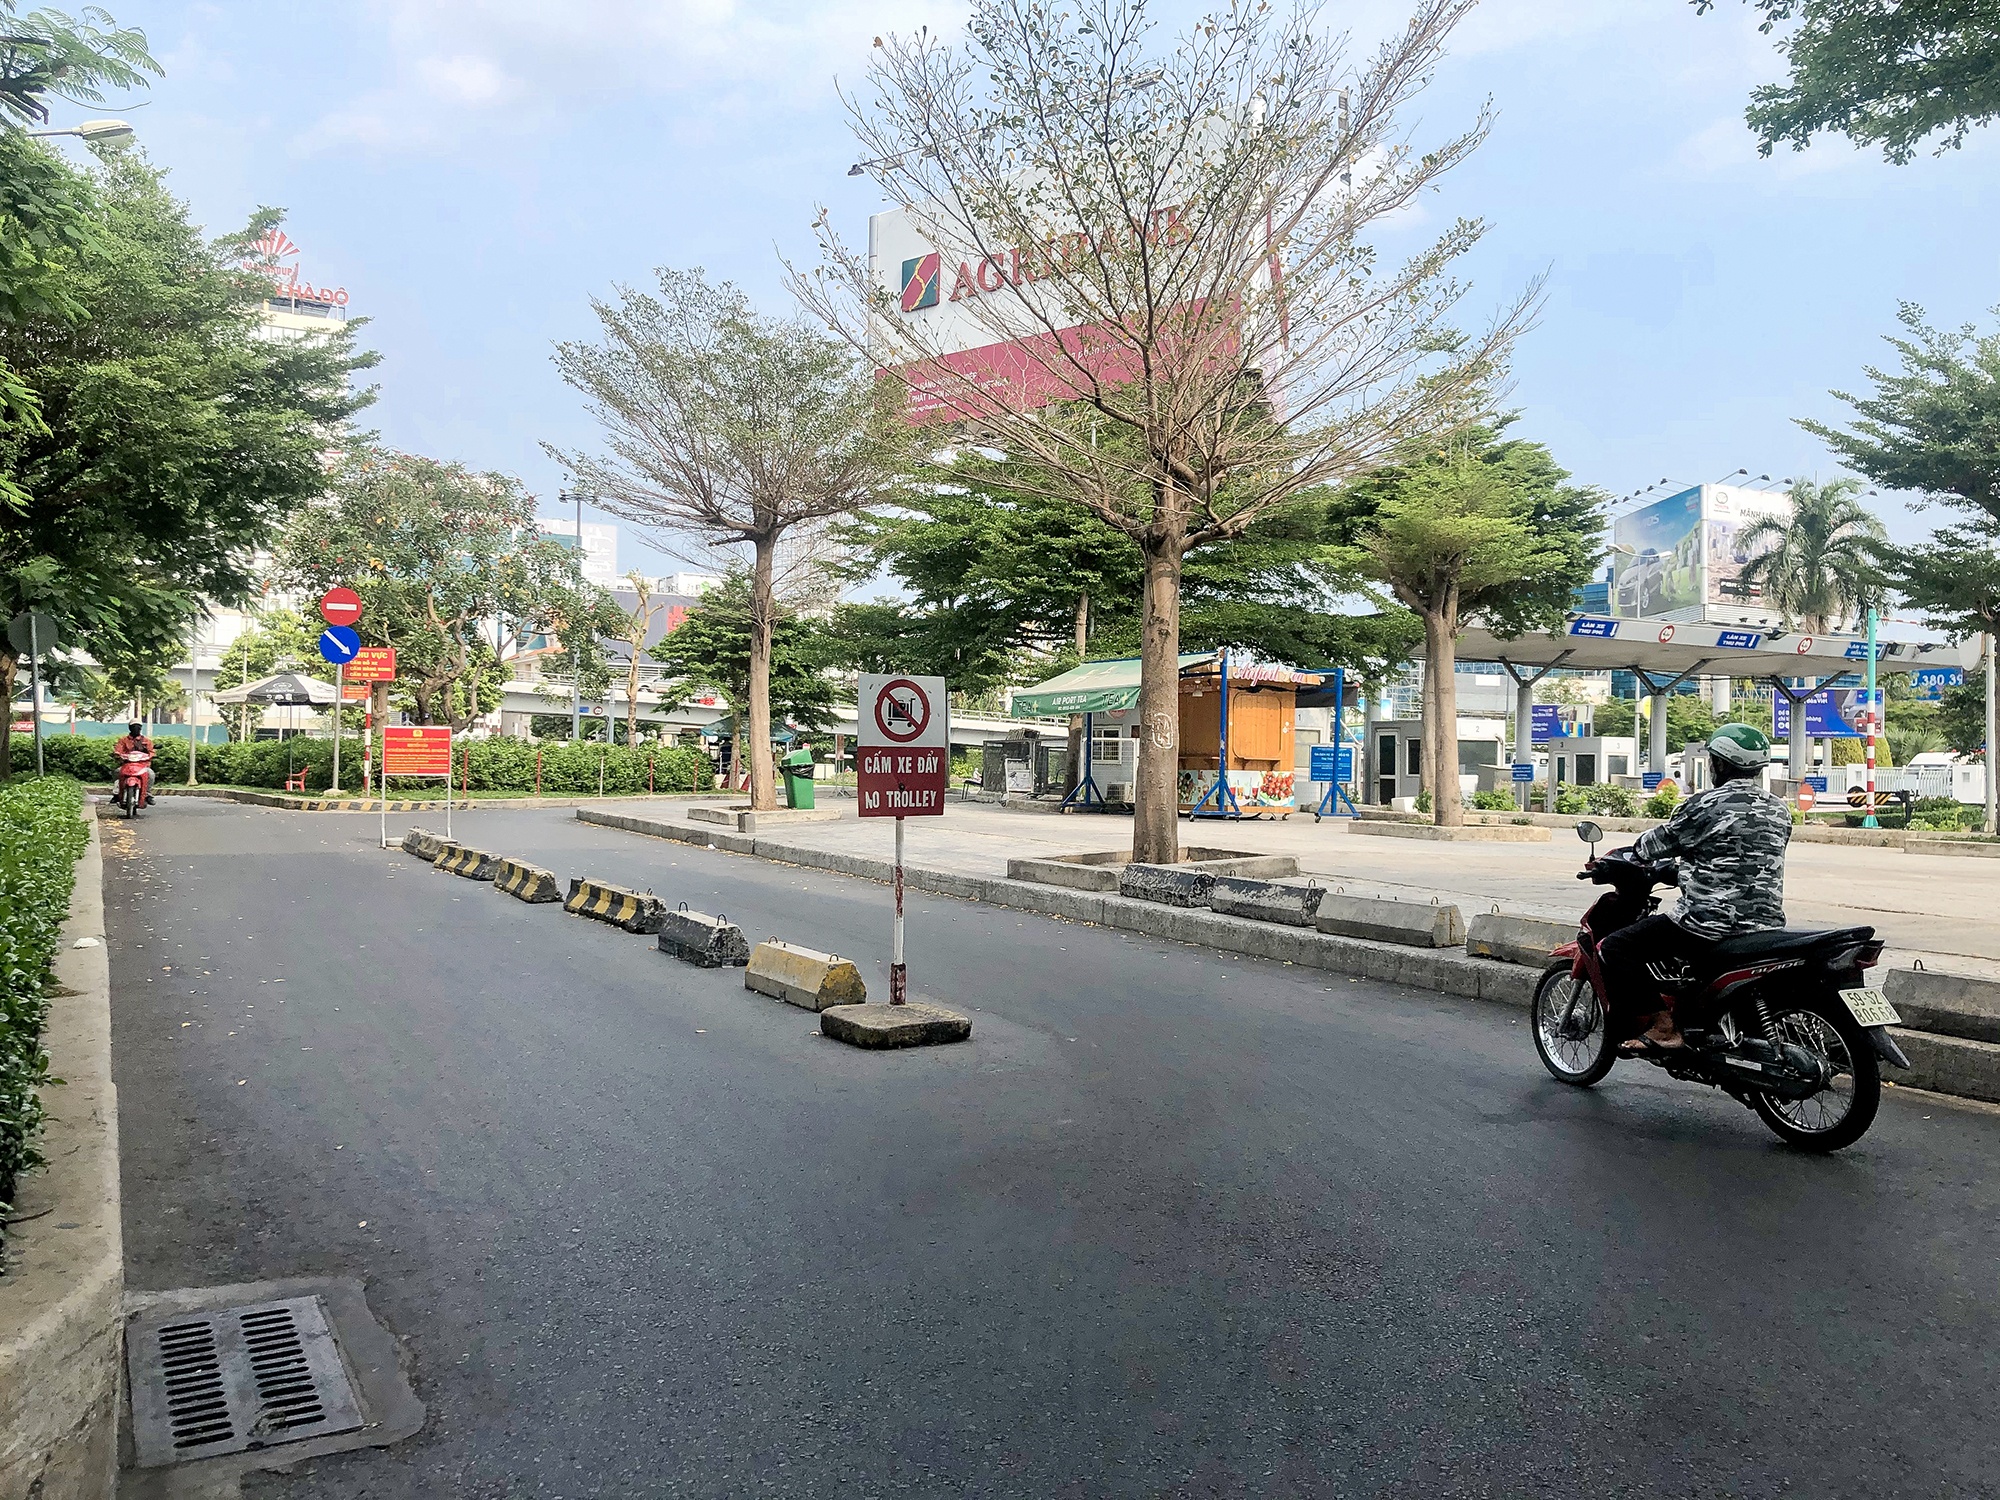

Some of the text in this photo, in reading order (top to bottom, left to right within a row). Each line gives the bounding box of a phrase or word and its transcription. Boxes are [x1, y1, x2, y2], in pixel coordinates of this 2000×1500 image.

[320, 287, 349, 305] ĐÔ
[864, 750, 939, 774] CẤM XE ĐẨY
[865, 790, 937, 809] NO TROLLEY
[1846, 991, 1883, 1007] 59-S2
